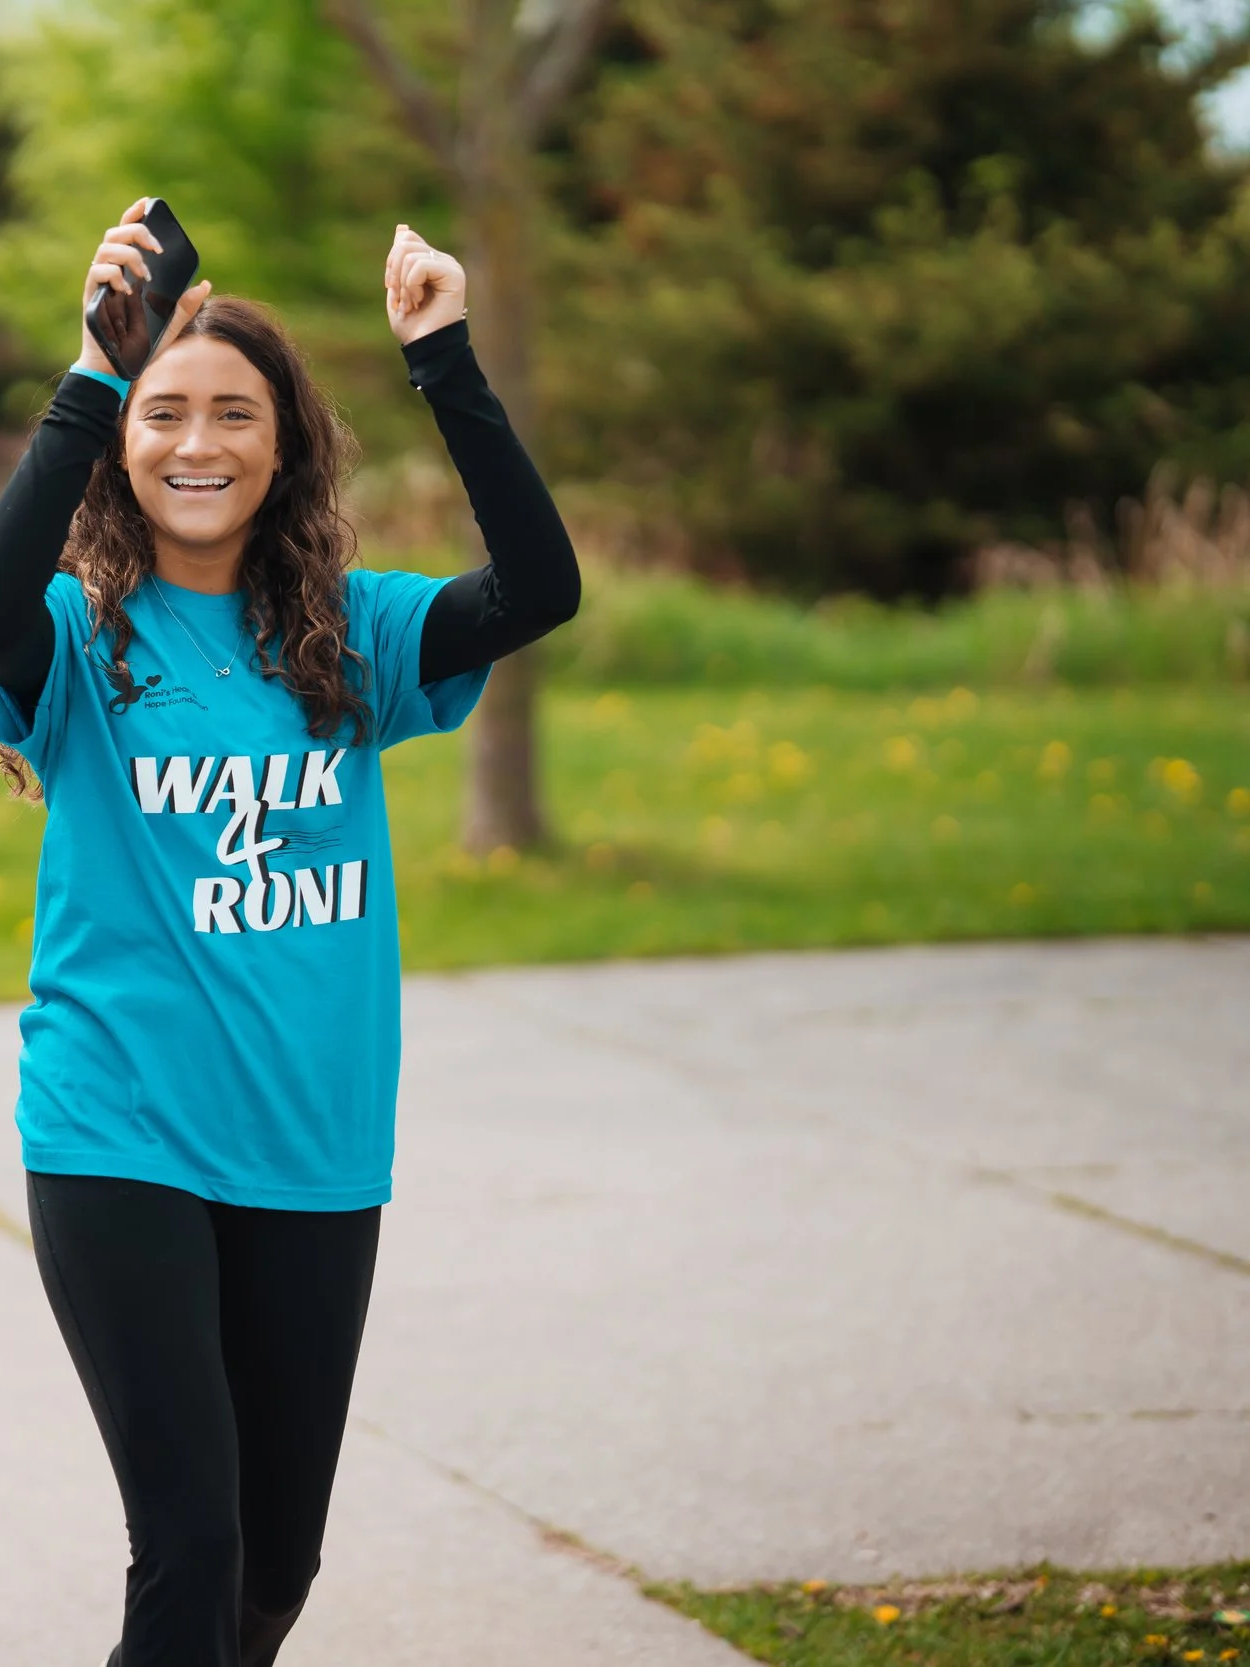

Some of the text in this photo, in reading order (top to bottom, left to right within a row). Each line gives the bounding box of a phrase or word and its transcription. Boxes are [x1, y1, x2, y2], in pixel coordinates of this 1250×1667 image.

[144, 689, 171, 699] Roni's
[144, 701, 167, 710] Hope
[130, 748, 347, 814] WALK
[216, 800, 290, 886] 4
[193, 859, 369, 934] RONI
